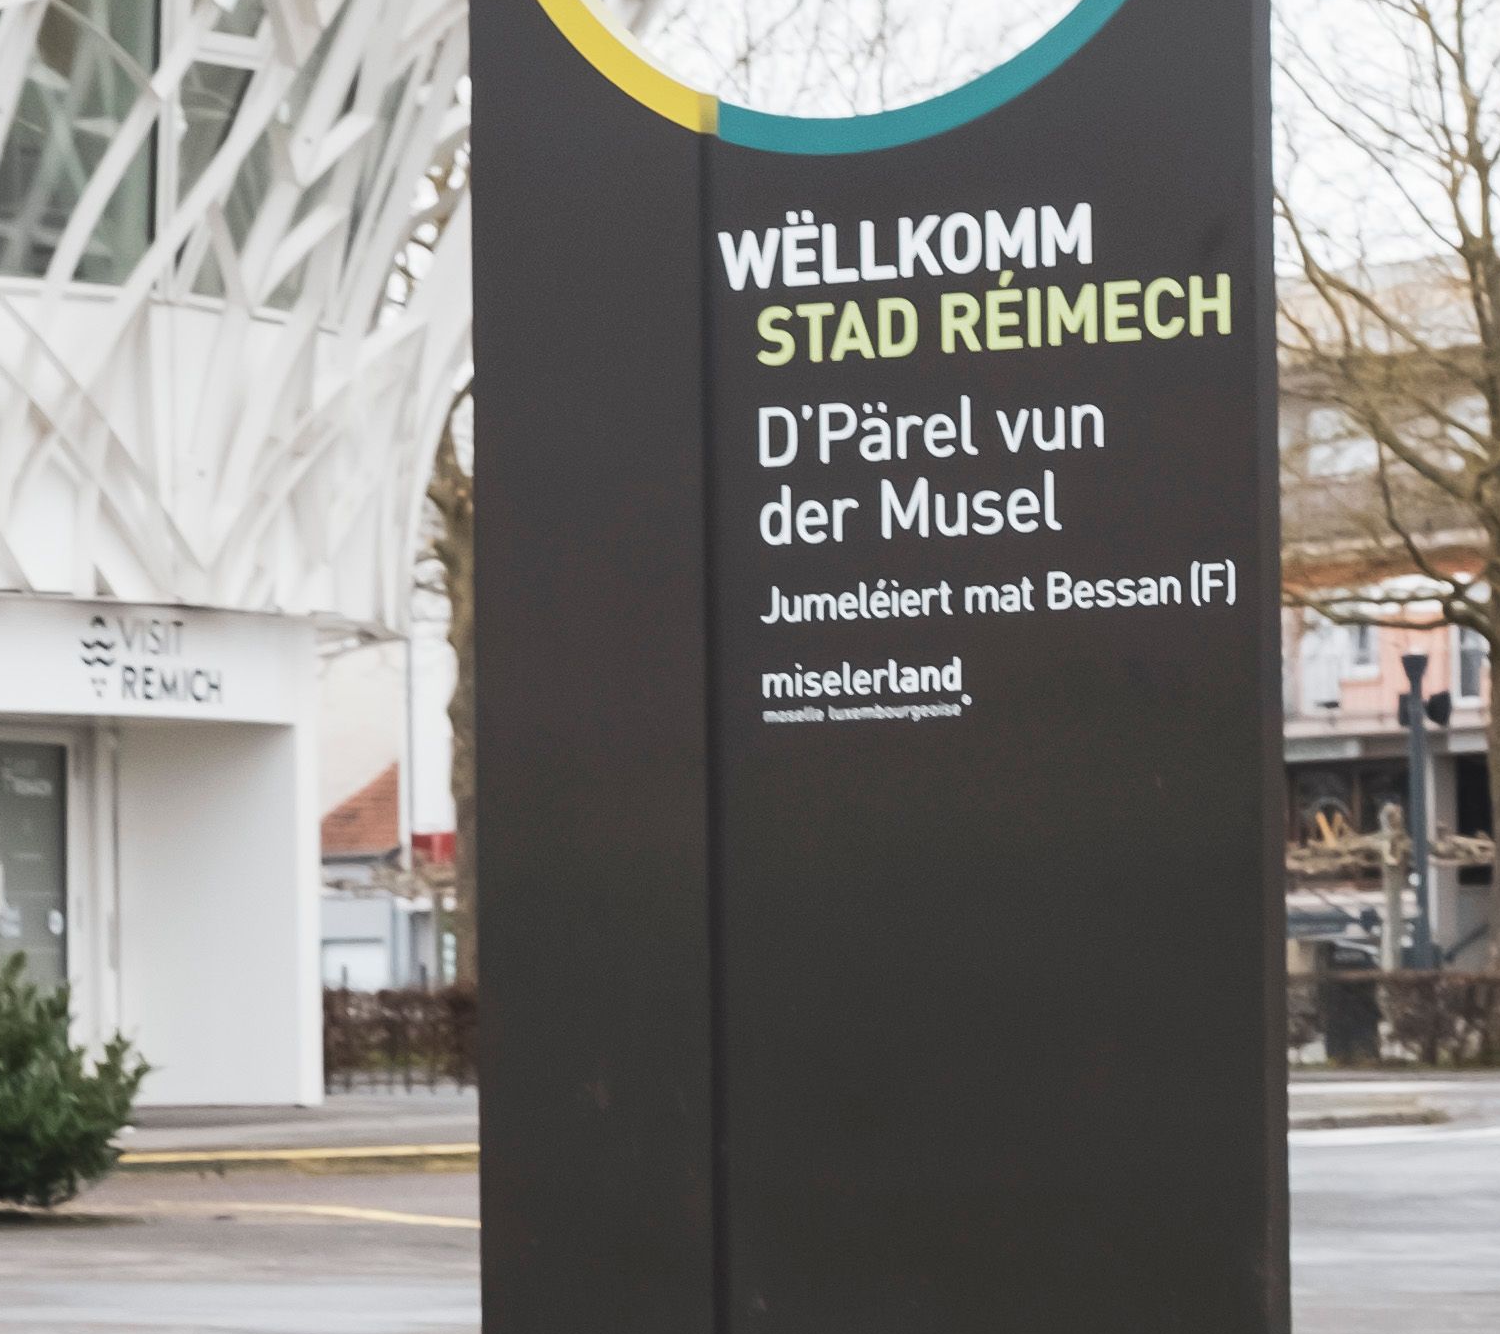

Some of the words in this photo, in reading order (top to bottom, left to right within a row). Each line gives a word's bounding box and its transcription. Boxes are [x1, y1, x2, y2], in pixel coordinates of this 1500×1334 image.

[717, 203, 1093, 292] WËLLKOMM
[756, 296, 919, 367] STAD
[940, 270, 1232, 354] RÉIMECH
[758, 394, 979, 468] D'Pärel
[995, 403, 1105, 454] vun
[759, 484, 860, 546] der
[880, 469, 1063, 540] Musel
[759, 578, 954, 625] Jumeléiert
[964, 575, 1035, 615] mat
[1046, 570, 1182, 611] Bessan
[1190, 558, 1237, 607] (F)
[116, 616, 184, 655] VISIT
[121, 665, 223, 703] REMICH
[761, 655, 963, 699] miselerland
